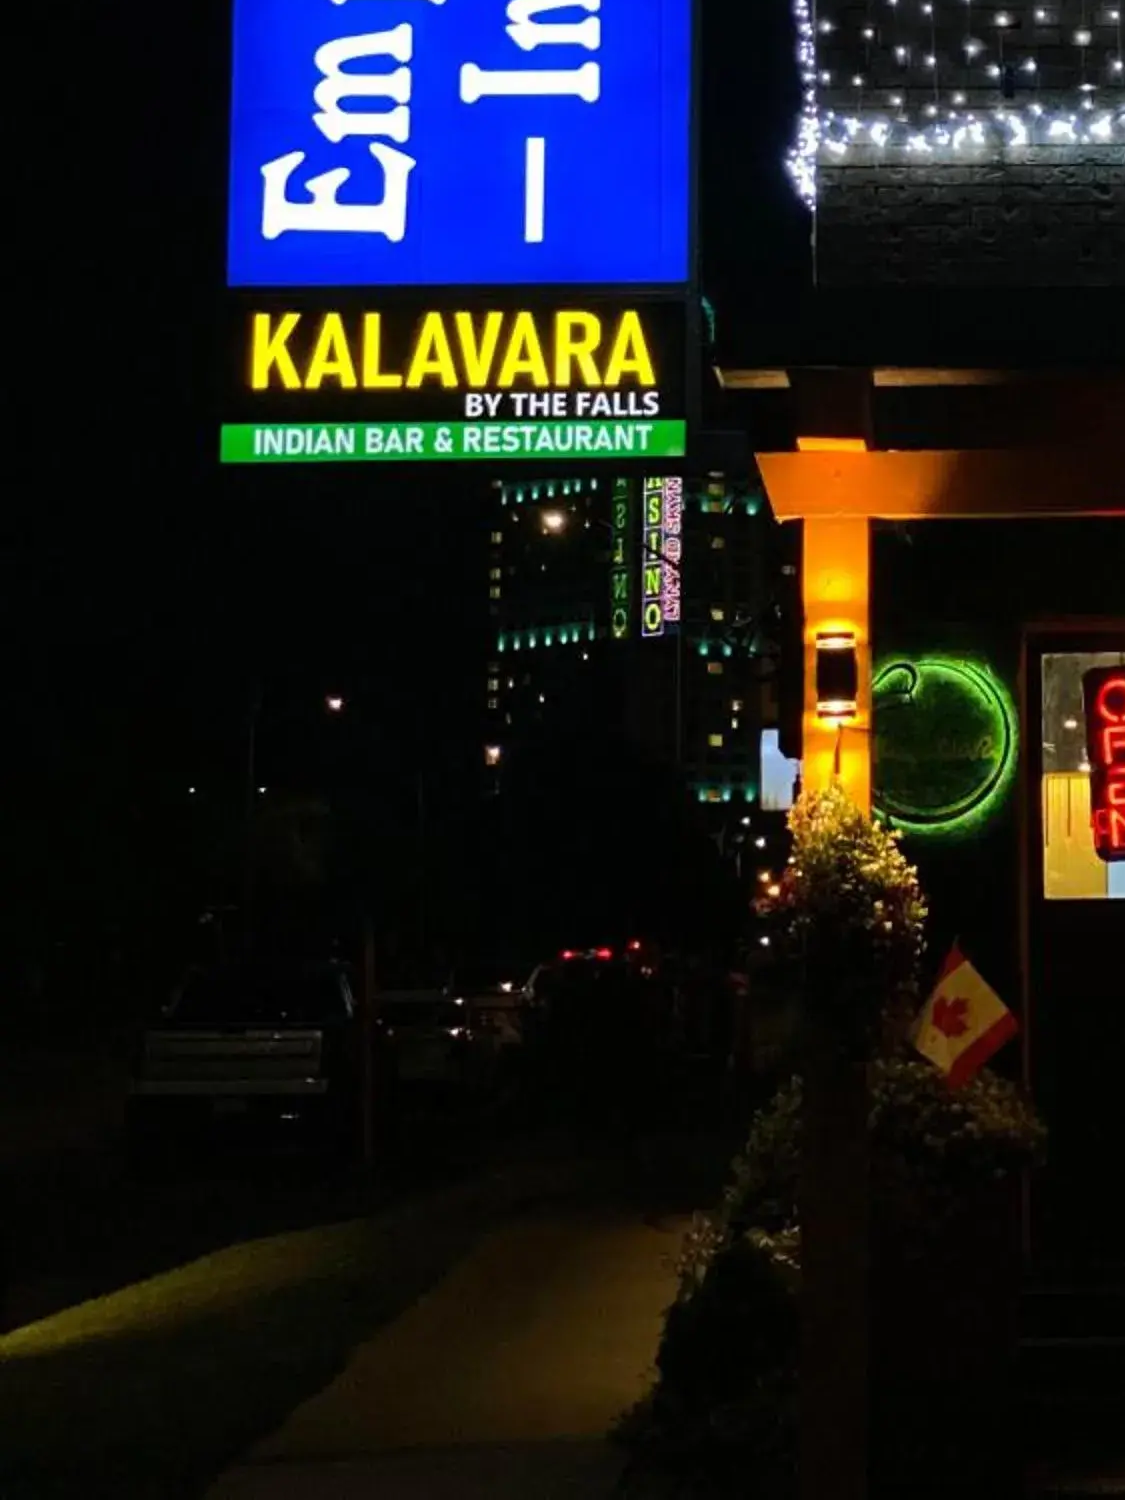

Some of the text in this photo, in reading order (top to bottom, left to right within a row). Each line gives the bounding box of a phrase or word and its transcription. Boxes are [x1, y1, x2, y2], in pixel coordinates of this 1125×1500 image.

[251, 311, 656, 389] KALAVARA
[465, 391, 660, 417] BY THE FALLS
[254, 423, 653, 456] INDIAN BAR & RESTAURANT
